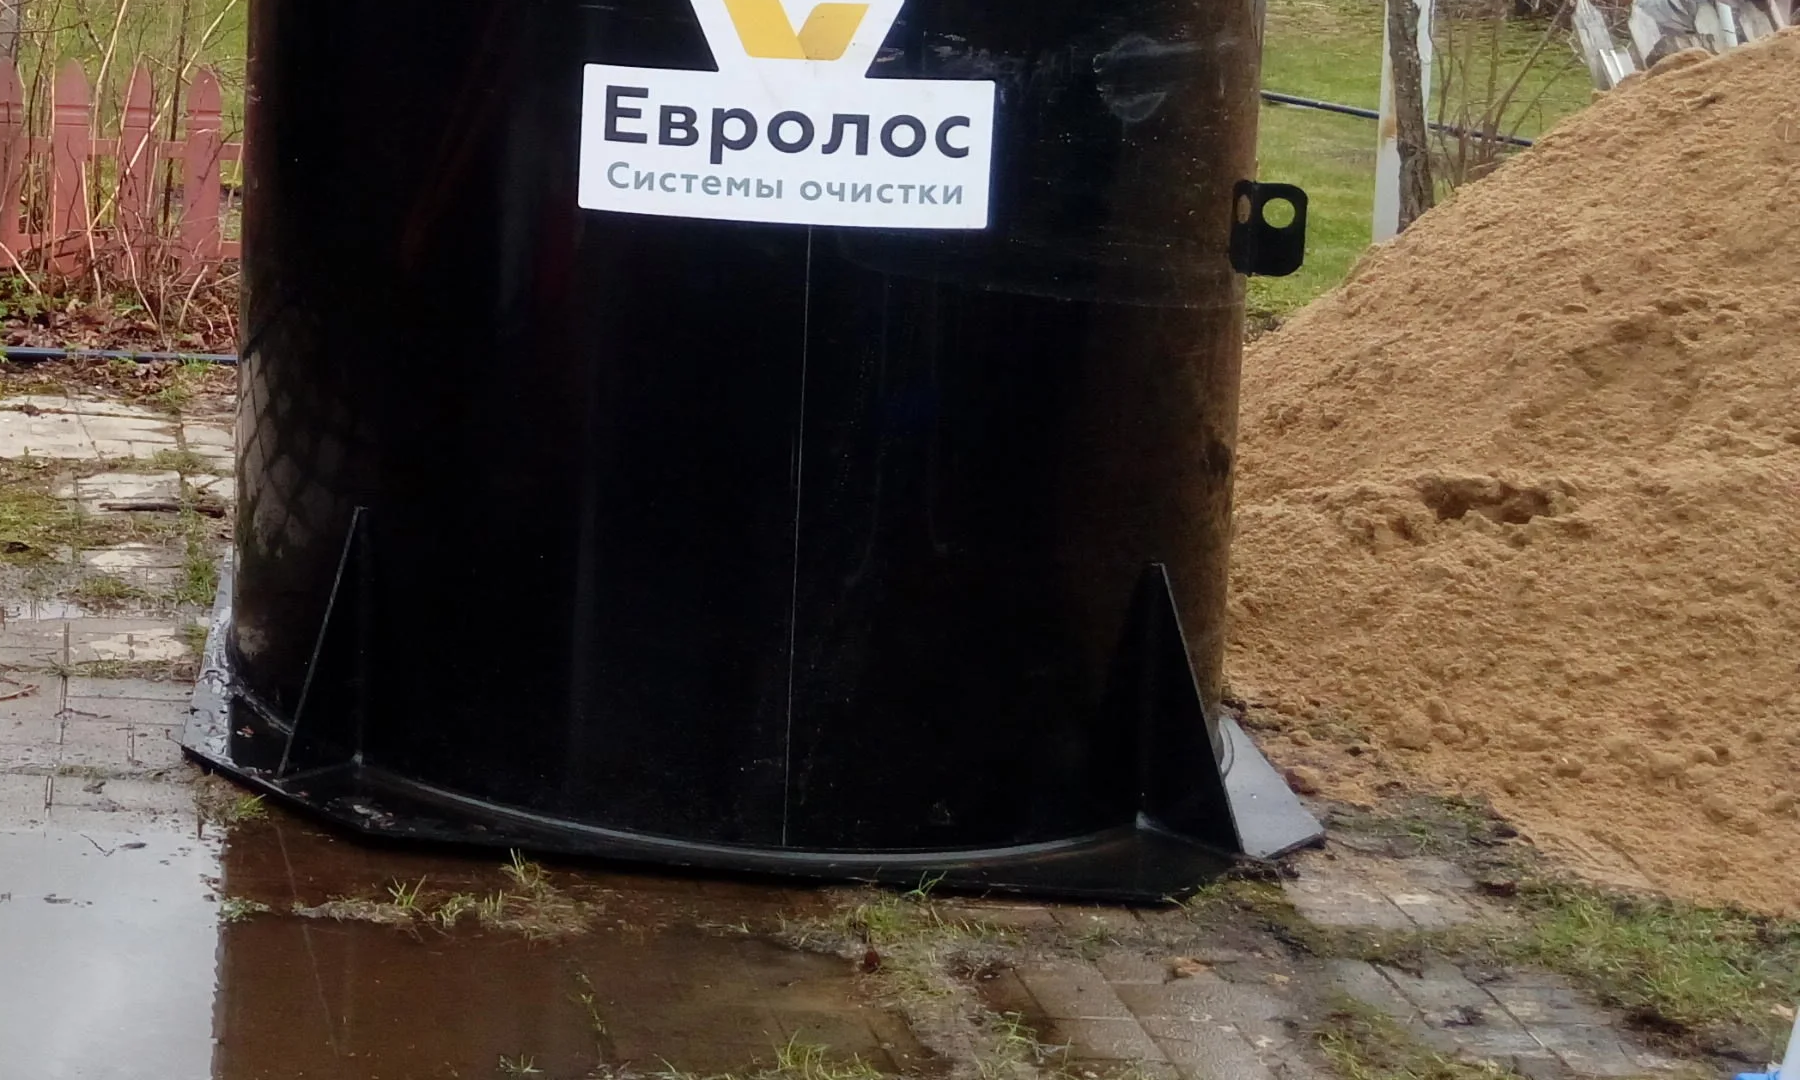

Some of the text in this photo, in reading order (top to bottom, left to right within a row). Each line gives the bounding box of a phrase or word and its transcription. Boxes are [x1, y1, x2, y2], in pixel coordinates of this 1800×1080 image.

[603, 84, 971, 165] Евролос
[606, 161, 964, 206] Системы очистки
